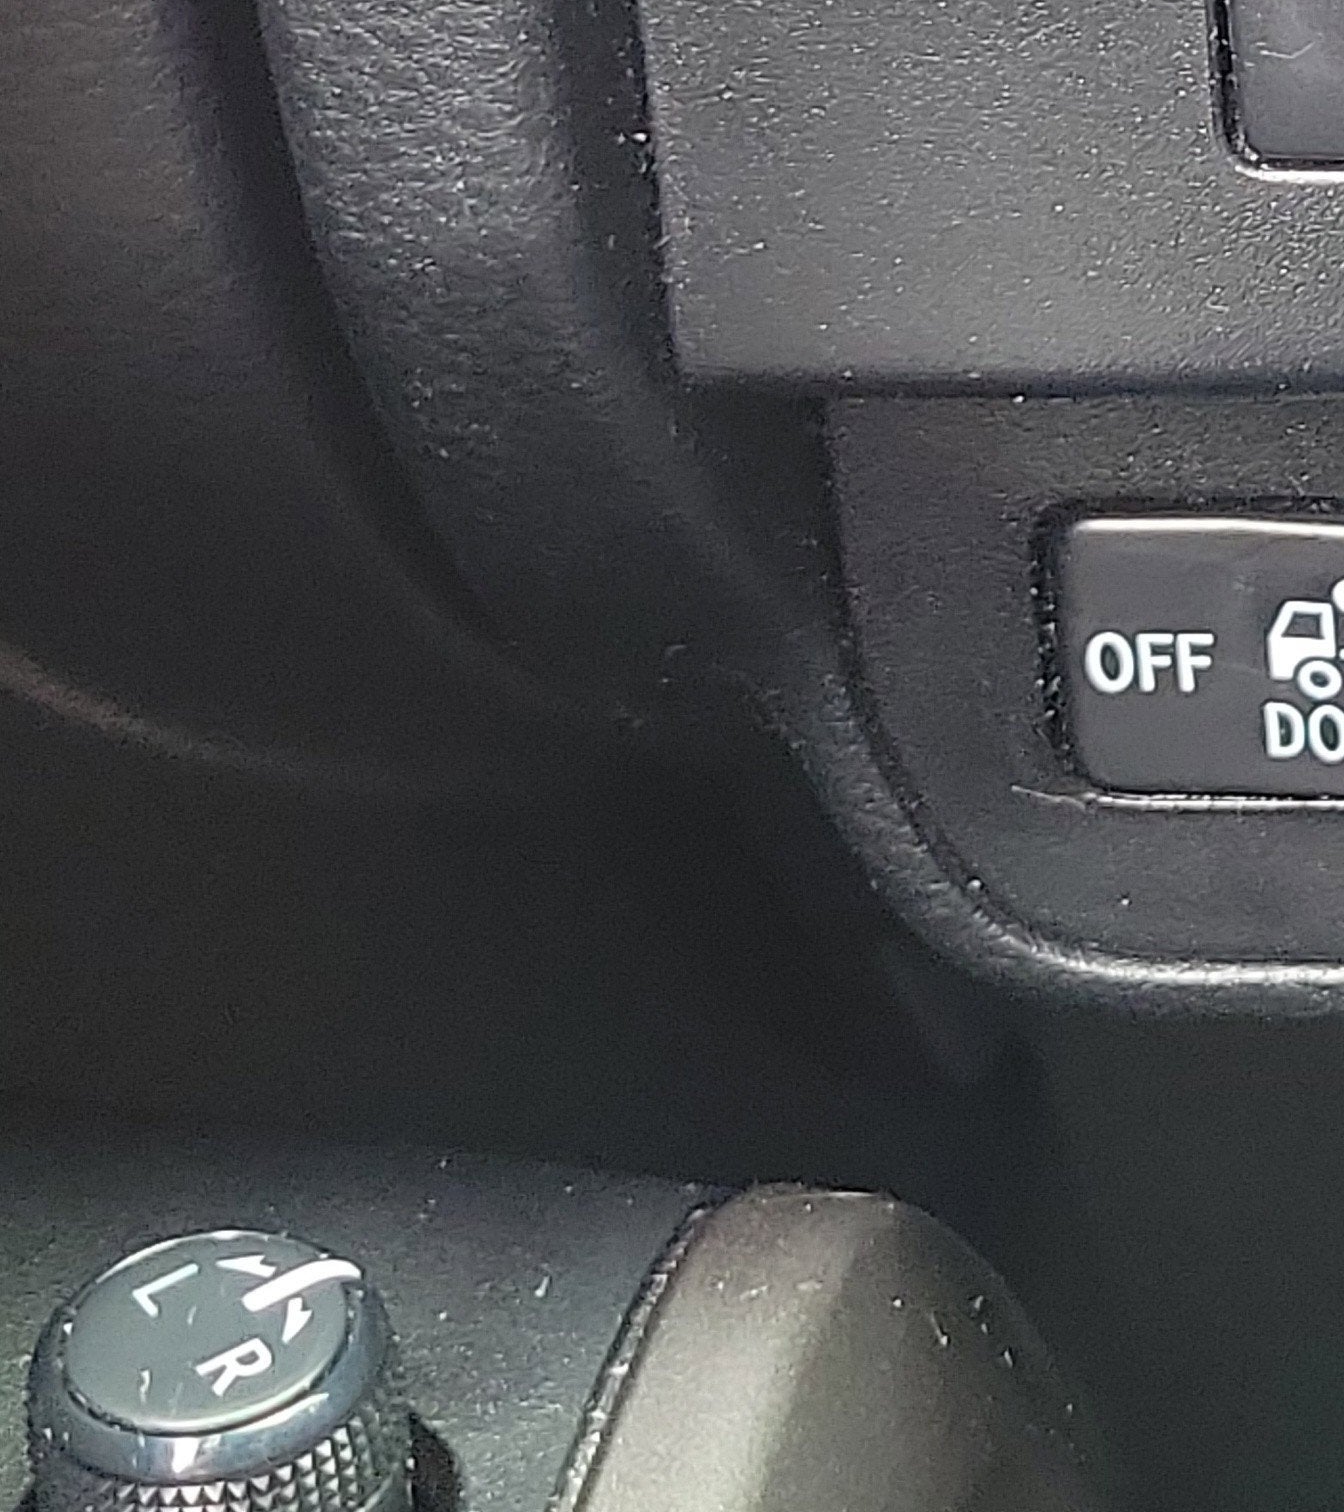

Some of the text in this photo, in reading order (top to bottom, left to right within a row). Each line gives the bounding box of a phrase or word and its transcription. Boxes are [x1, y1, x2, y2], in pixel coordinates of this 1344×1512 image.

[1084, 631, 1214, 694] OFF
[132, 1263, 198, 1317] L
[196, 1338, 273, 1397] R
